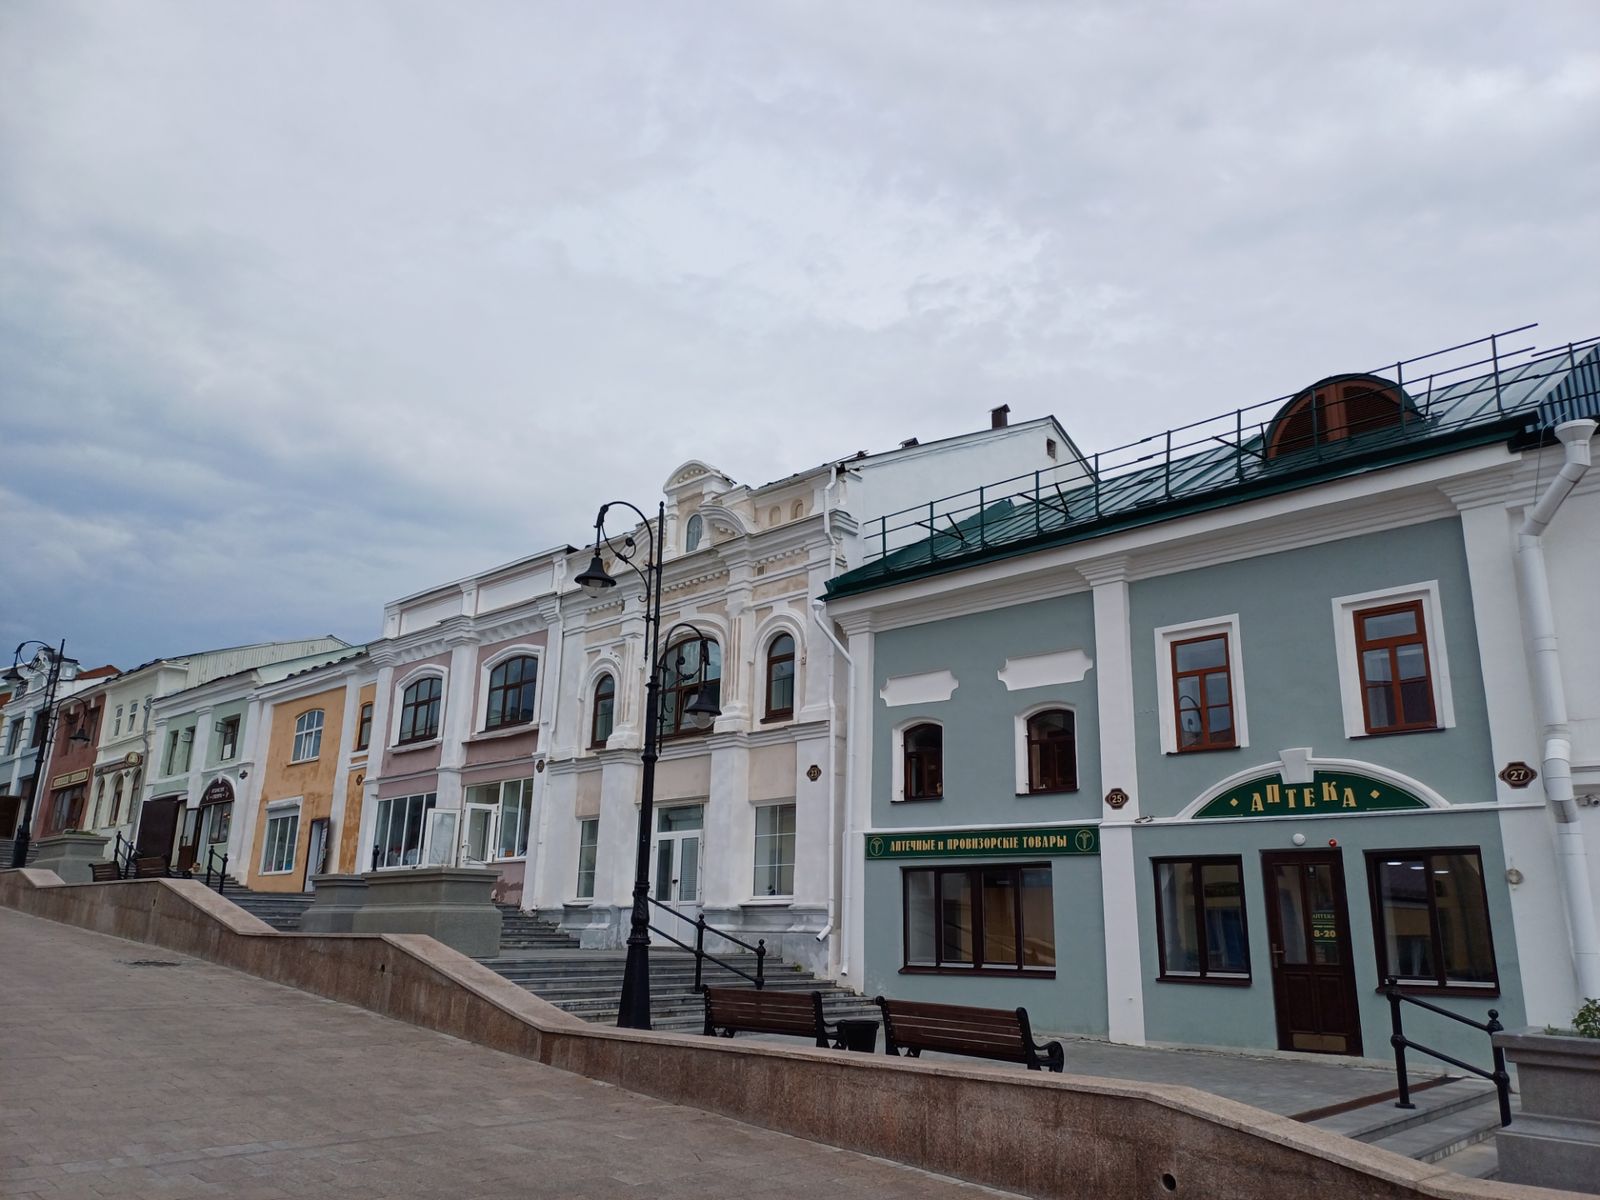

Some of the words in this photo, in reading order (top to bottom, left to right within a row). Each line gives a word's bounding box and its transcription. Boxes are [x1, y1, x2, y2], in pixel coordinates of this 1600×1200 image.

[1510, 770, 1525, 780] 27
[1111, 794, 1122, 803] 25
[1251, 781, 1357, 812] АПТЕКА
[890, 840, 936, 852] АПТЕЧНЫЕ
[1023, 835, 1067, 848] ТОВАРЫ
[1313, 930, 1336, 938] 8-20
